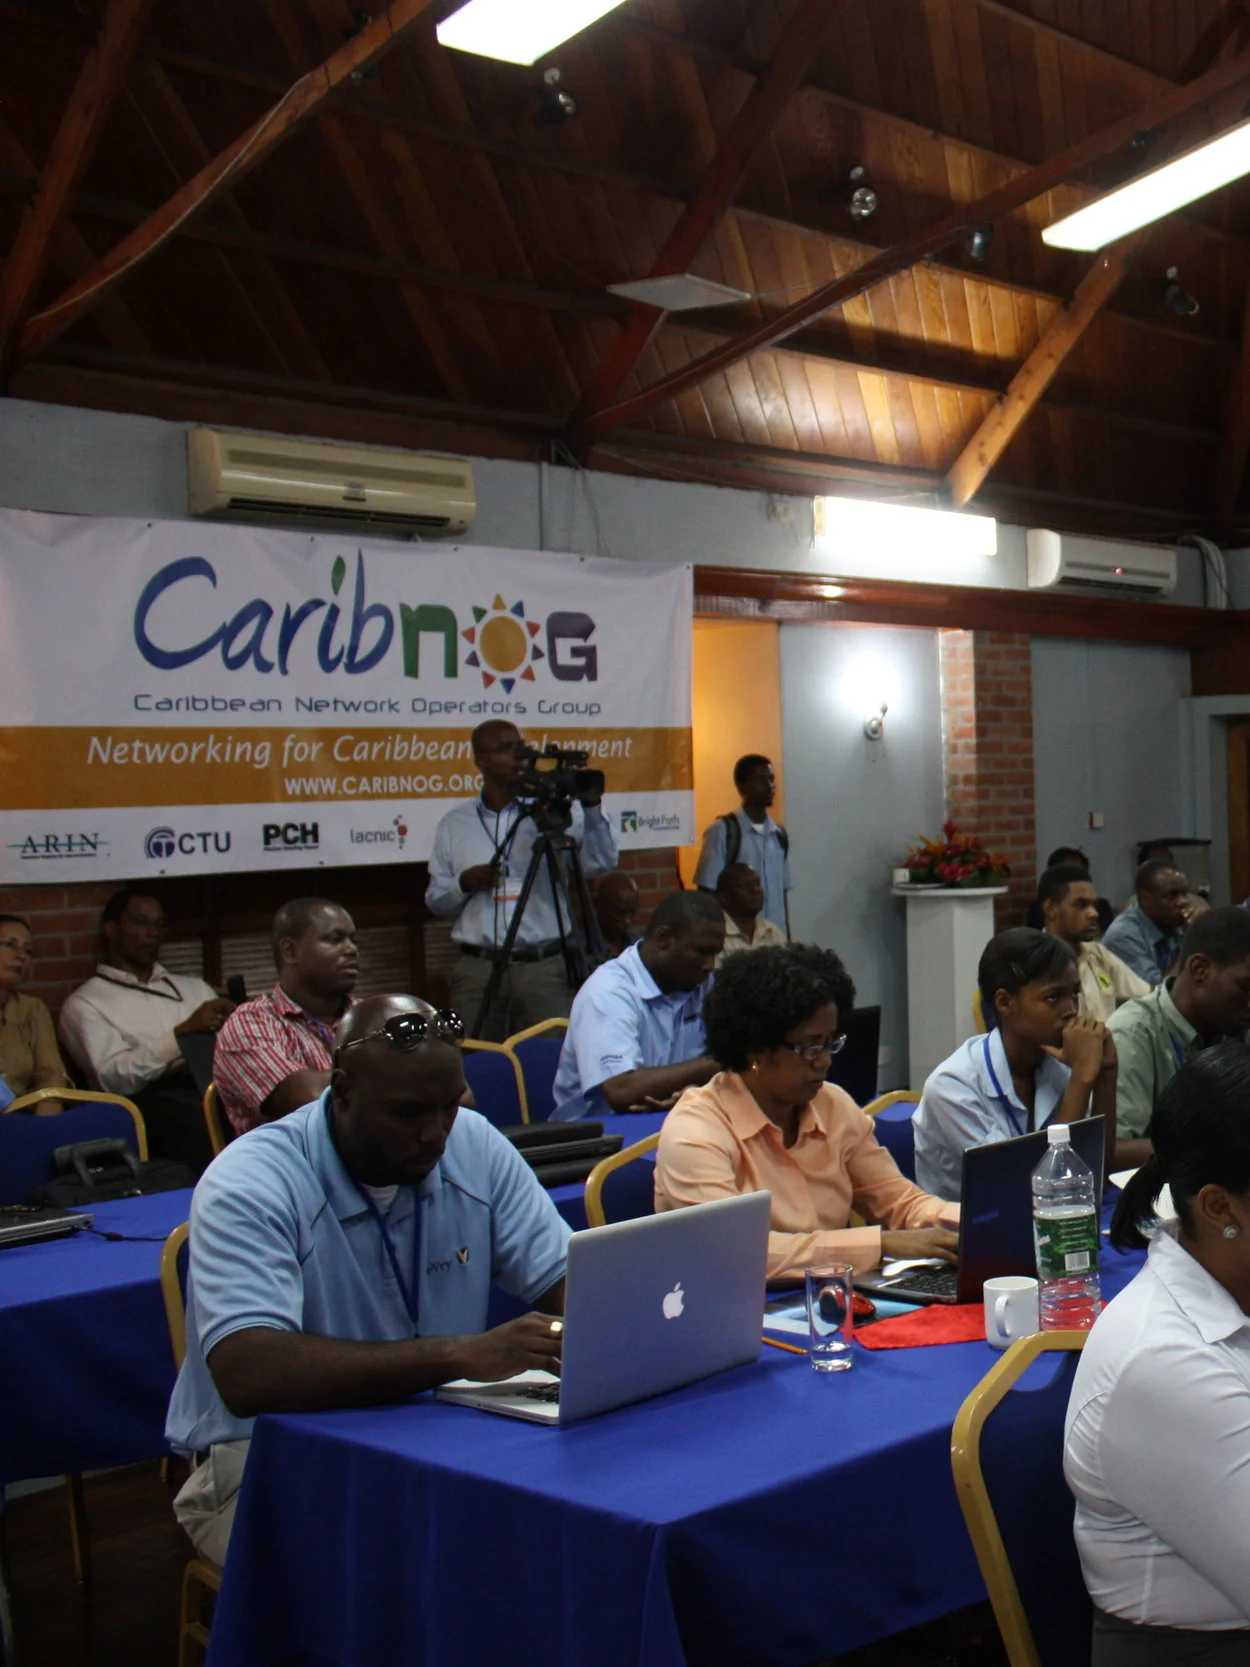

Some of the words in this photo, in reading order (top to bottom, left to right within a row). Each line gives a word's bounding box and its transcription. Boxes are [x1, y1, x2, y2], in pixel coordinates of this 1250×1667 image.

[134, 694, 282, 712] Caribbean
[295, 696, 400, 713] Network
[411, 697, 526, 716] Operators
[538, 699, 602, 717] Group
[87, 734, 272, 769] Networking
[282, 734, 324, 769] for
[333, 734, 471, 762] Caribbean
[285, 774, 484, 796] WWW.CARIBNOG.ORG
[21, 833, 99, 853] ARIN
[178, 831, 231, 855] CTU
[263, 822, 319, 845] PCH
[350, 829, 396, 844] lacnic
